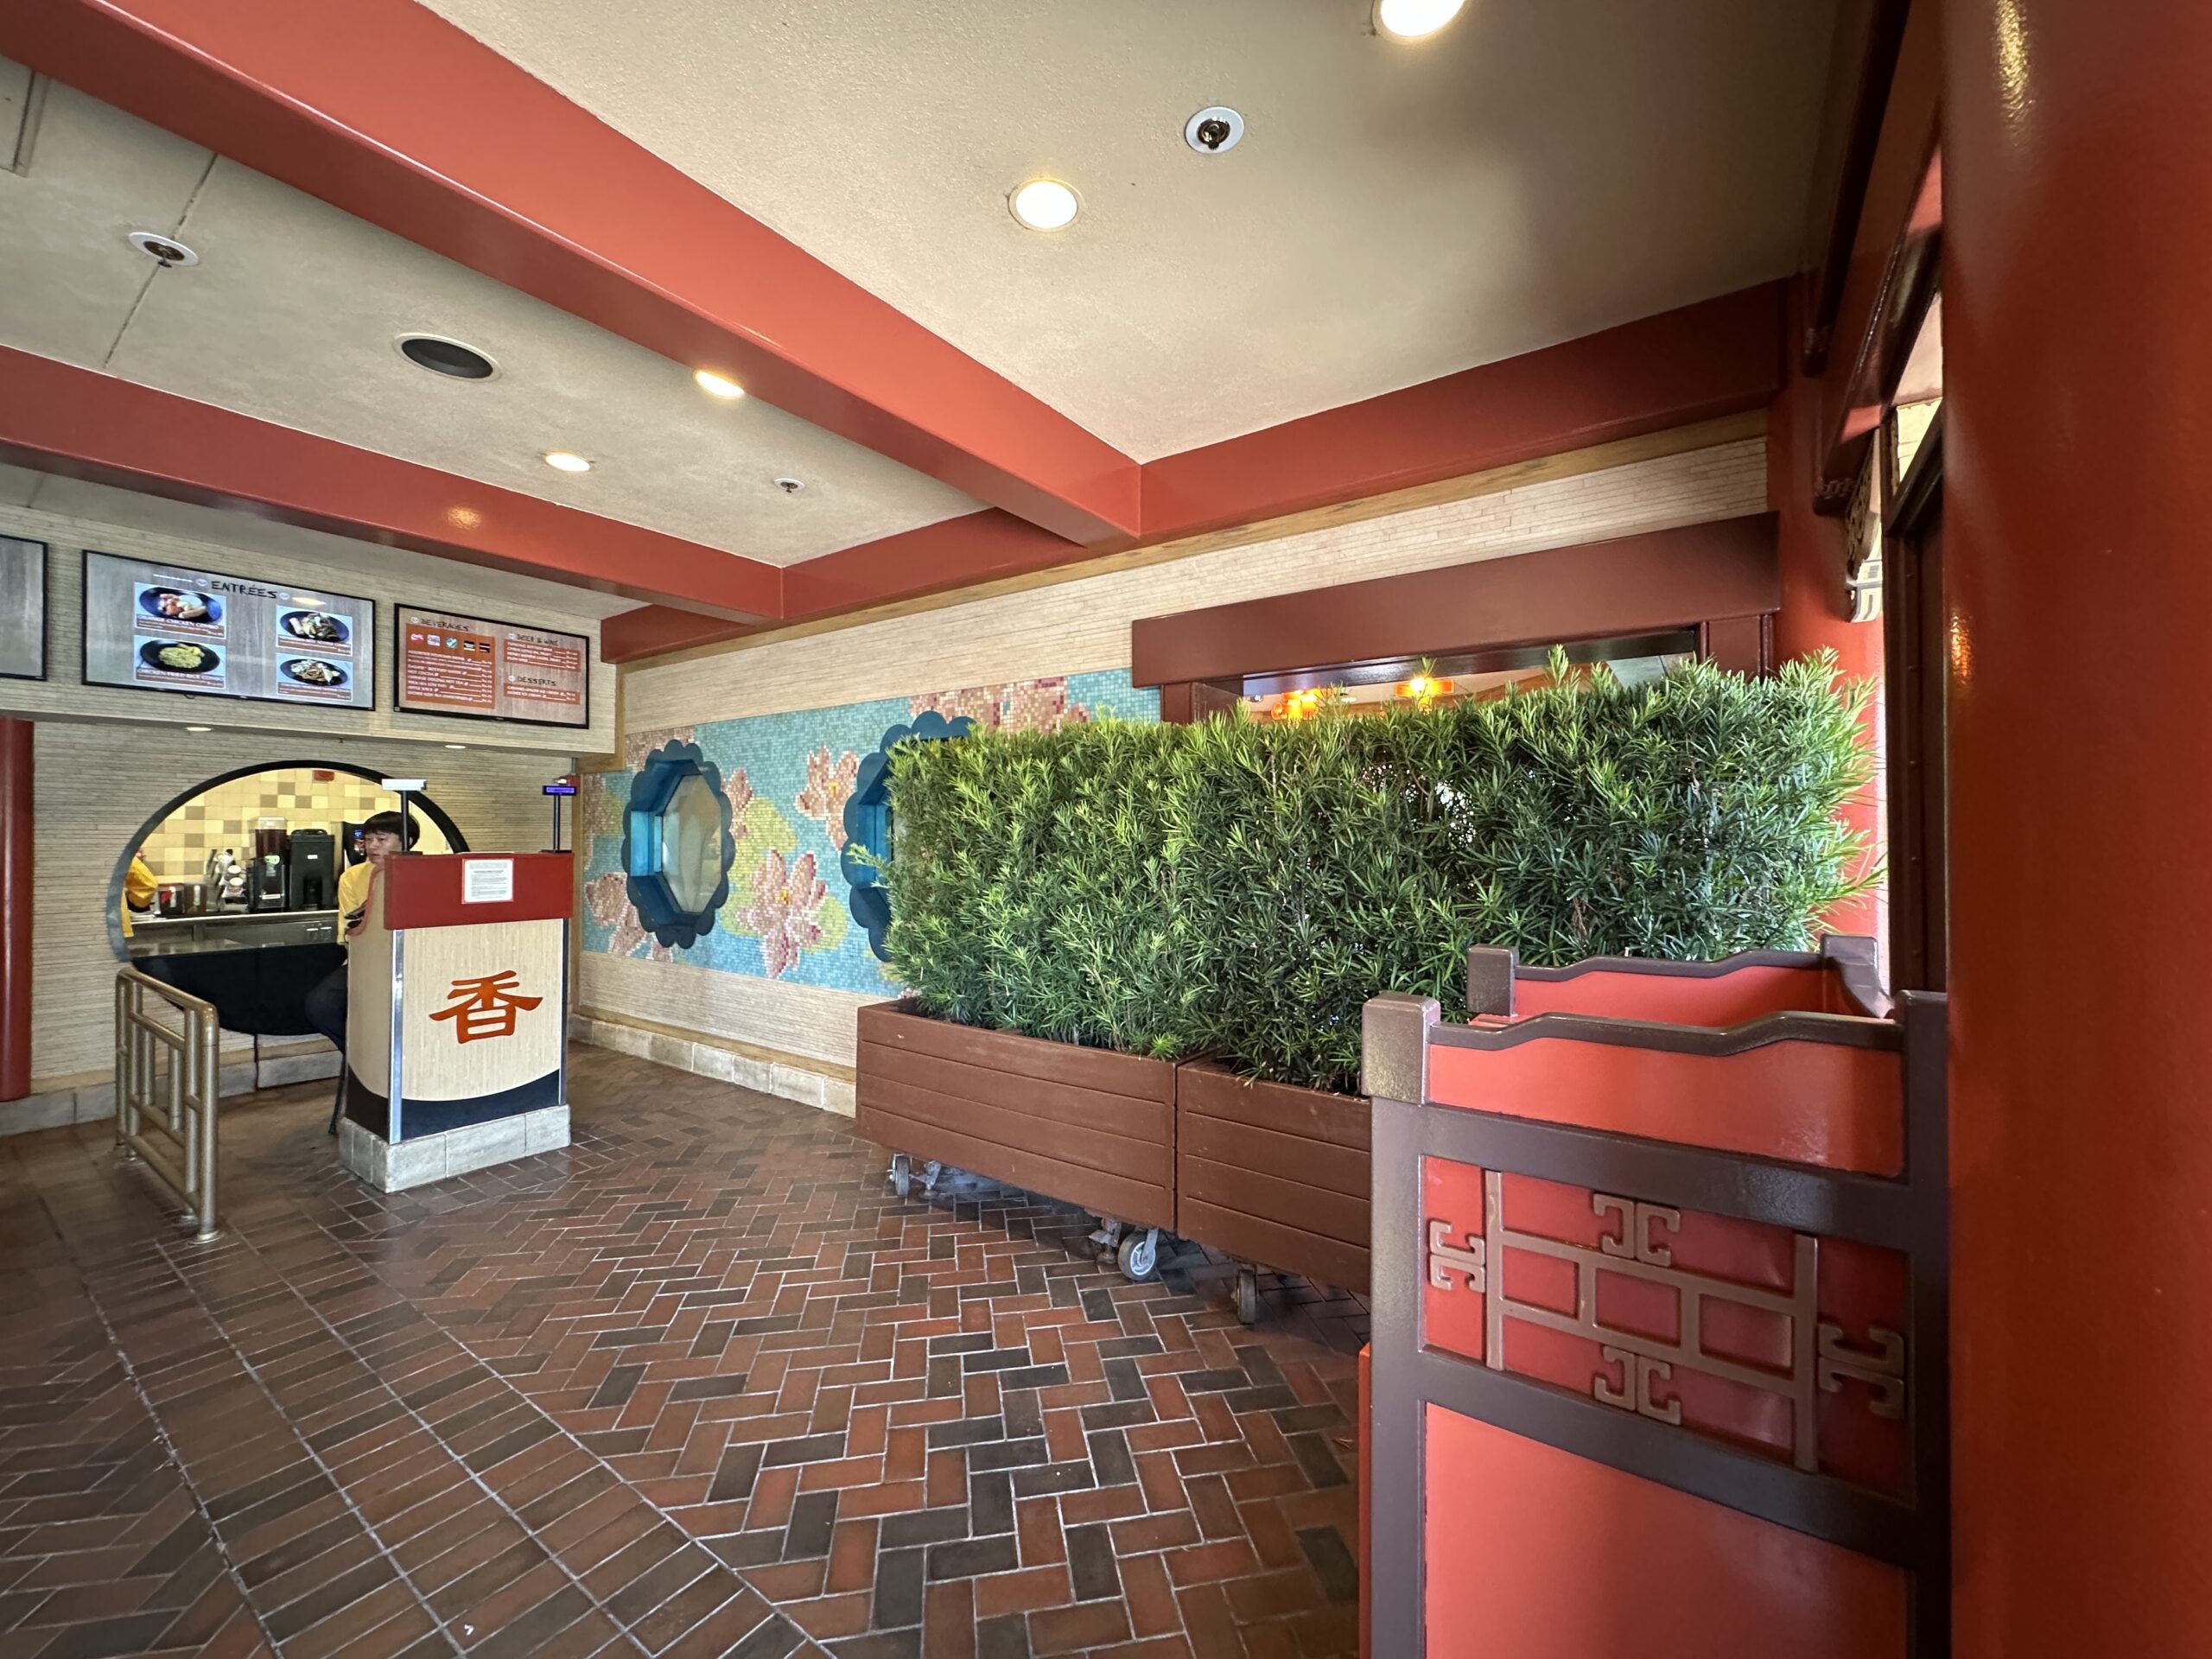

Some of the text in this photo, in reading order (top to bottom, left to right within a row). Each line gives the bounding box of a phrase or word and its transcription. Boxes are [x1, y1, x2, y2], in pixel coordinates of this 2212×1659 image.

[211, 581, 277, 599] ENTRÉES
[421, 618, 470, 632] BEVERAGES
[518, 676, 557, 686] DESSERTS
[429, 969, 543, 1045] 香
